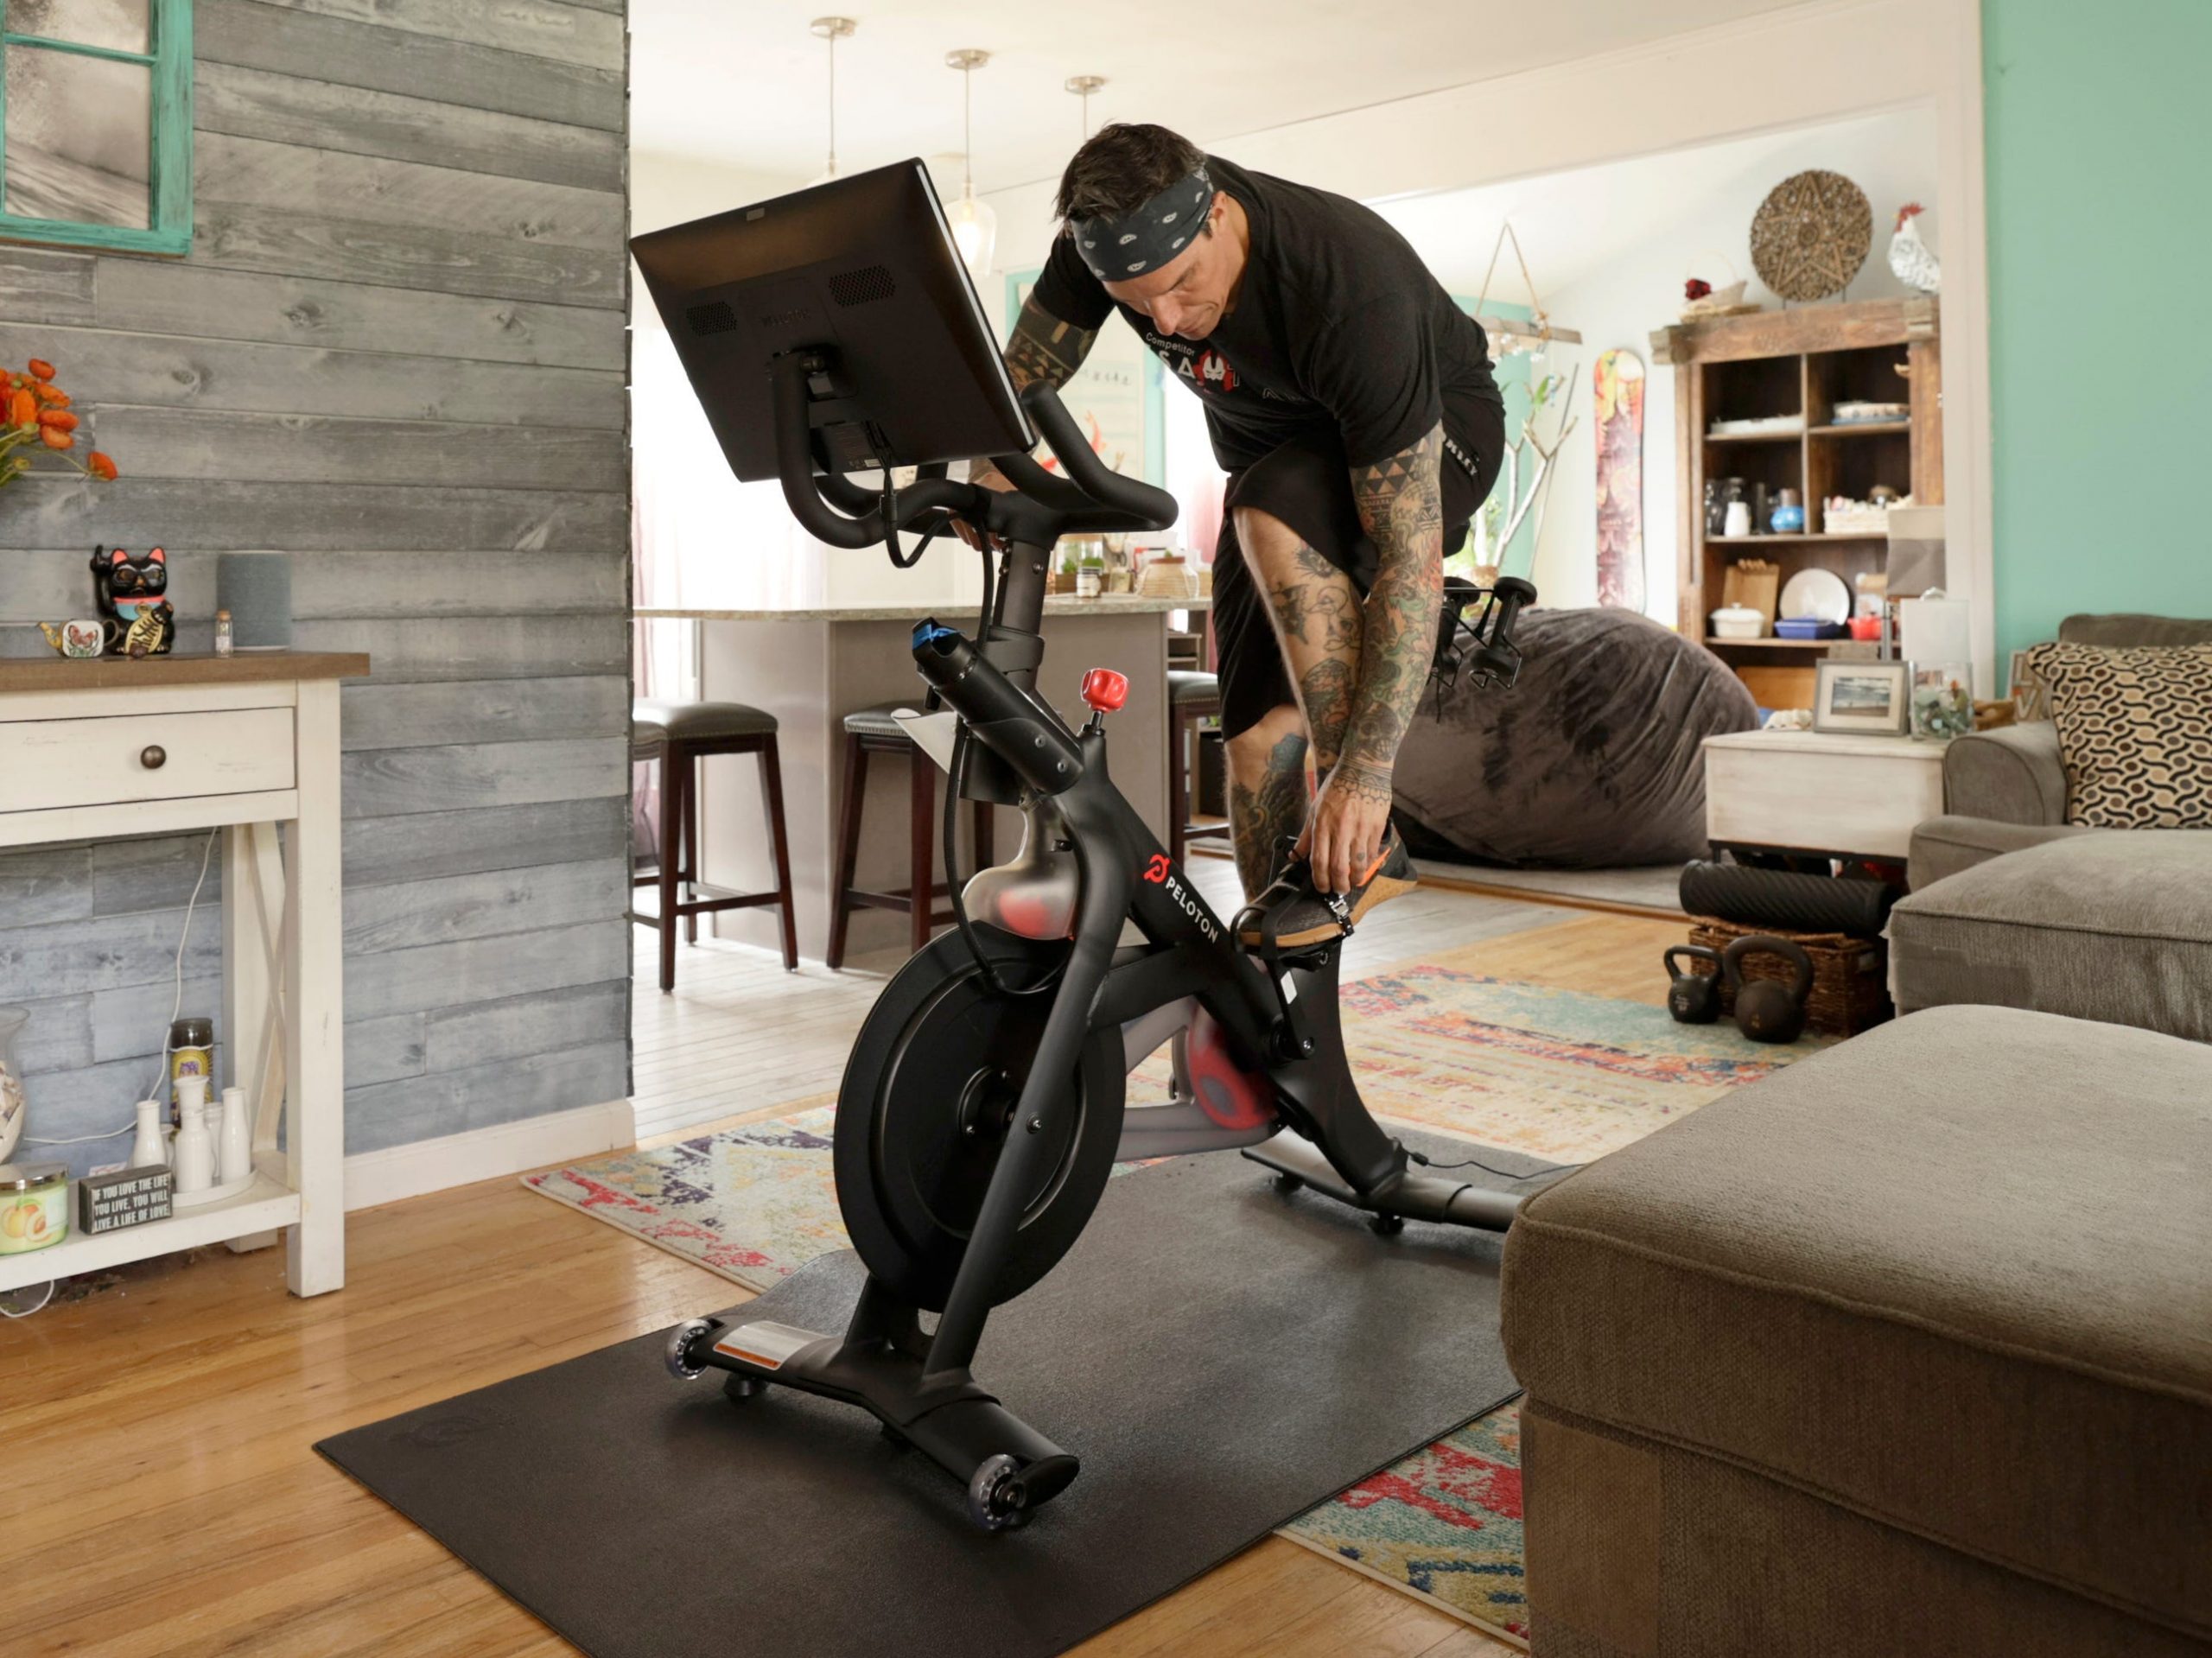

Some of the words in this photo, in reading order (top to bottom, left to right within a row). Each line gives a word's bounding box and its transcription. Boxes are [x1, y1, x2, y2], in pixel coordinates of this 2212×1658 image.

[1145, 332, 1195, 357] Competitor
[1165, 875, 1218, 944] PELOTON
[103, 1184, 118, 1199] YOU
[119, 1180, 137, 1197] LOVE
[138, 1177, 153, 1191] THE
[153, 1173, 168, 1188] LIFE
[95, 1202, 111, 1217] YOU
[132, 1193, 149, 1208] YOU
[149, 1189, 168, 1204] WILL
[93, 1217, 112, 1232] LIVE
[112, 1214, 120, 1227] A
[121, 1210, 137, 1226] LIFE
[137, 1208, 149, 1222] OF
